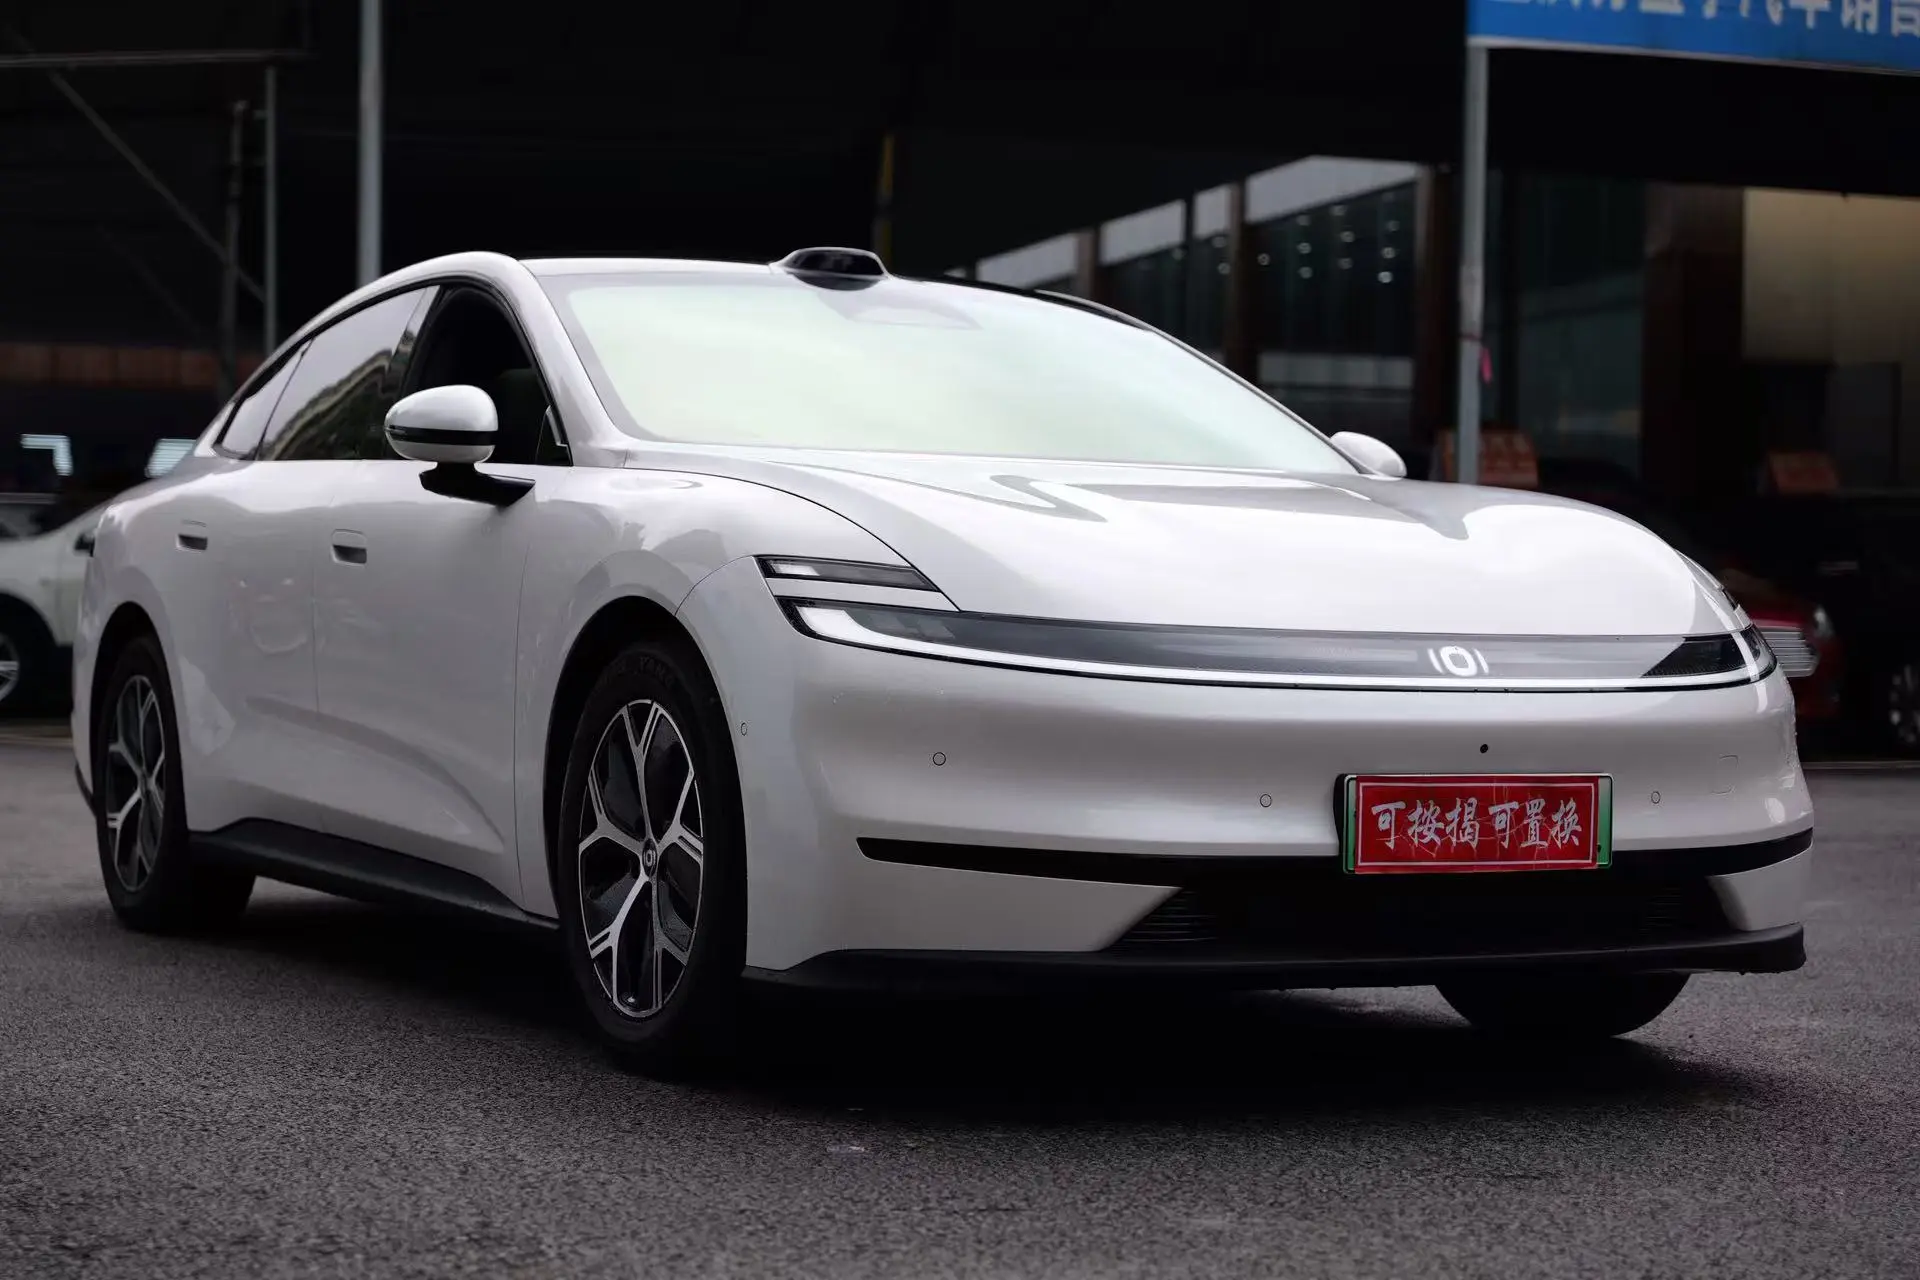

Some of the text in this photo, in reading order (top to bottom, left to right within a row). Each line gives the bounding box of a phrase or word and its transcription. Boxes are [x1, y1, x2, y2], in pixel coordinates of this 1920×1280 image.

[1371, 798, 1582, 849] 可按揭可置换
